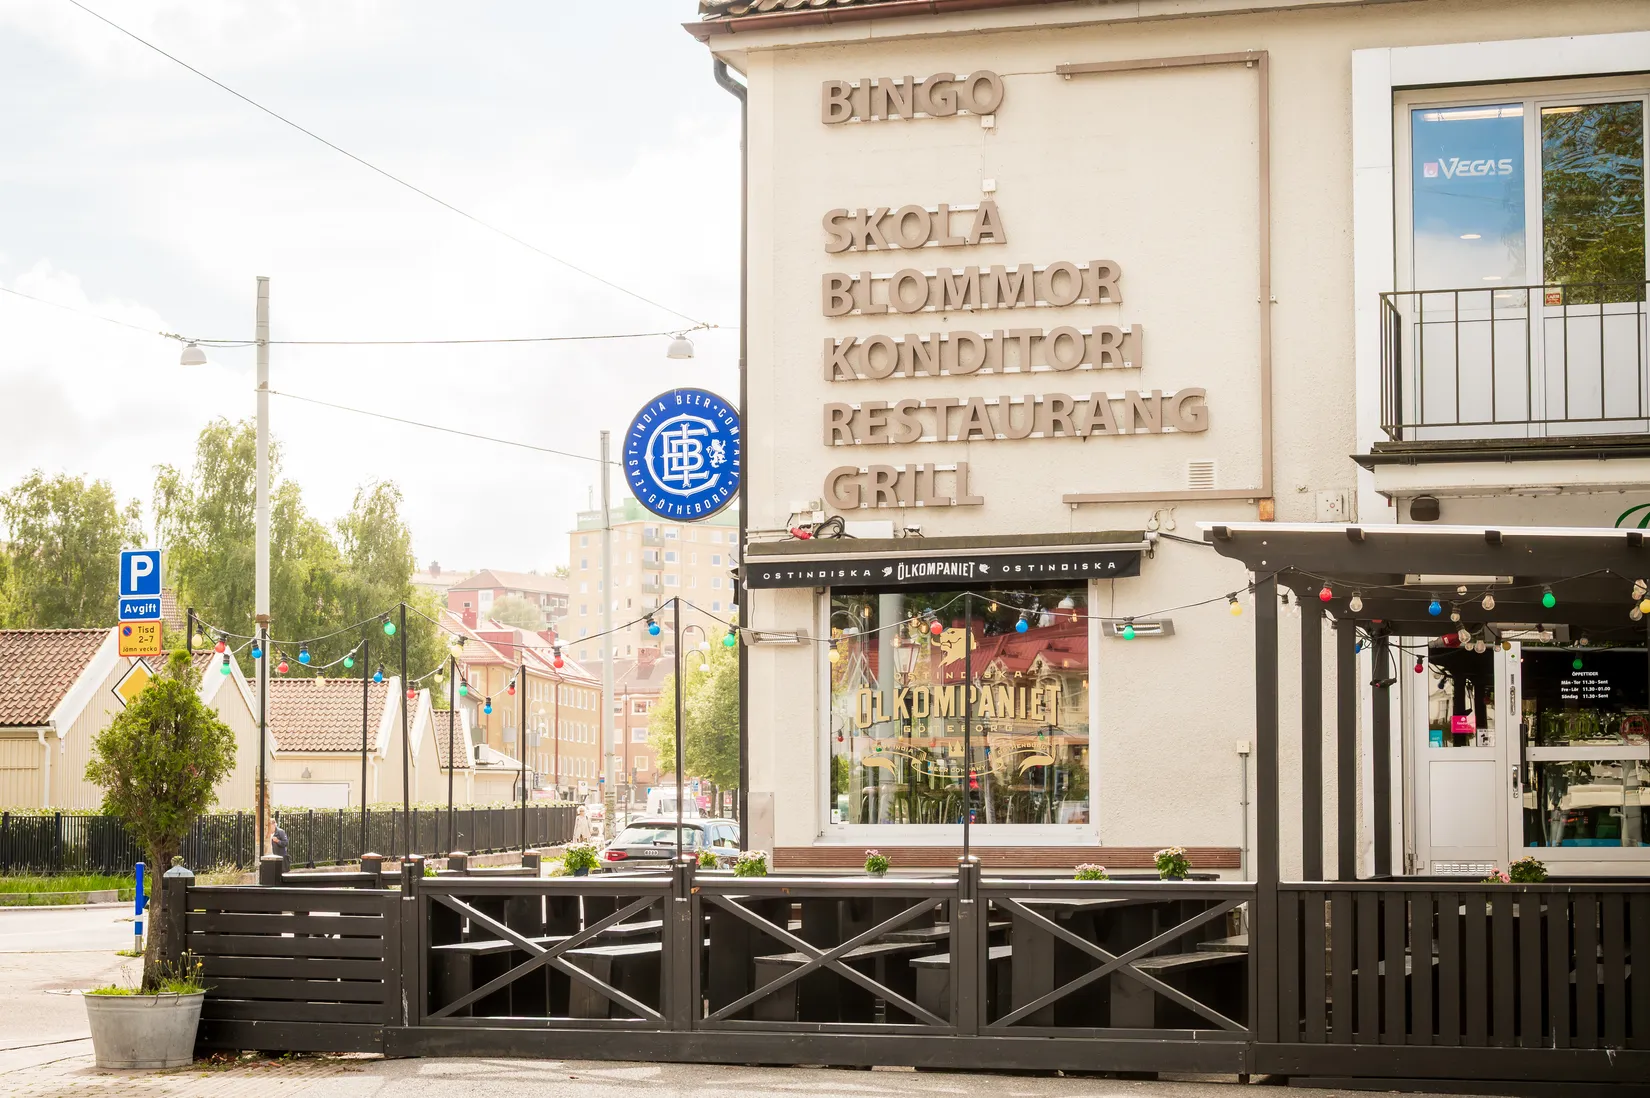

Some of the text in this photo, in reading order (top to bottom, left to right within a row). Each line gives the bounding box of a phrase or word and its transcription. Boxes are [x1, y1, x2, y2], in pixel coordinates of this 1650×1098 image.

[822, 70, 1004, 124] BINGO
[1438, 158, 1513, 179] VEGAS
[822, 200, 1007, 253] SKOLA
[822, 260, 1122, 317] BLOMMOR
[823, 324, 1143, 381] KONDITORI
[676, 394, 711, 408] BEER
[824, 388, 1208, 446] RESTAURANG
[633, 402, 666, 438] INDIA
[629, 450, 644, 487] EAST
[824, 462, 984, 510] GRILL
[648, 486, 728, 515] GÖTHEBORG
[130, 555, 154, 591] P
[763, 562, 1116, 580] OSTINDISKA ÖLKOMPANIET OSTINDISKA
[124, 603, 157, 615] Avgift
[894, 670, 1023, 679] OSTINDISKA
[856, 683, 1062, 728] ÖLKOMPANIET
[903, 723, 1013, 733] GÖTEBORG
[950, 764, 986, 773] COMANY
